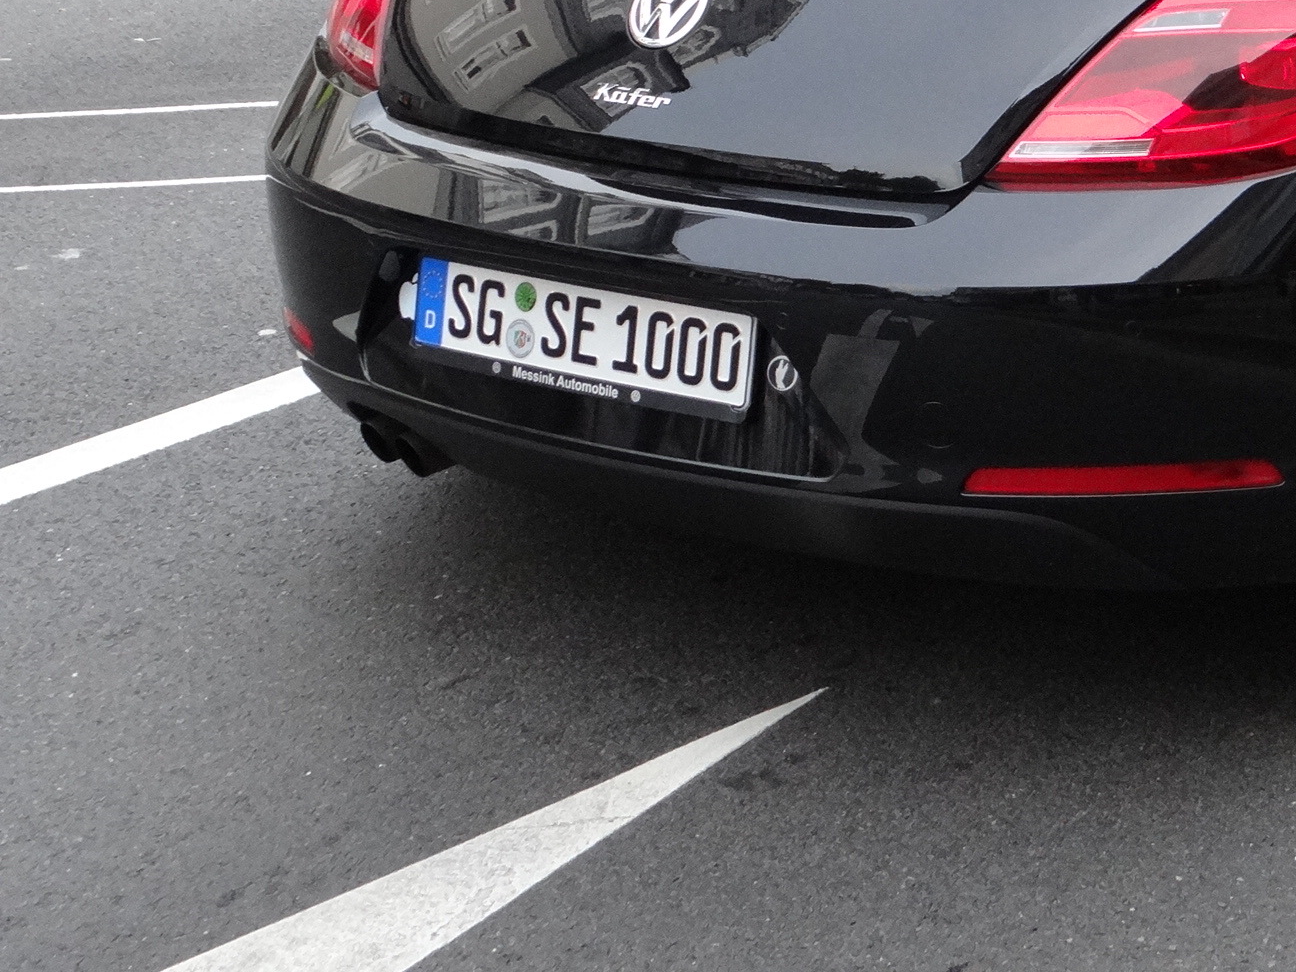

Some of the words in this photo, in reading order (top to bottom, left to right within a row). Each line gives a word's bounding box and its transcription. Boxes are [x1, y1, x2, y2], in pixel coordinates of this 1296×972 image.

[593, 82, 672, 109] Käfer
[424, 309, 436, 329] D
[447, 274, 506, 347] SG
[540, 291, 603, 367] SE
[611, 304, 743, 392] 1000
[512, 364, 556, 387] Messink
[556, 373, 619, 400] Automobile
